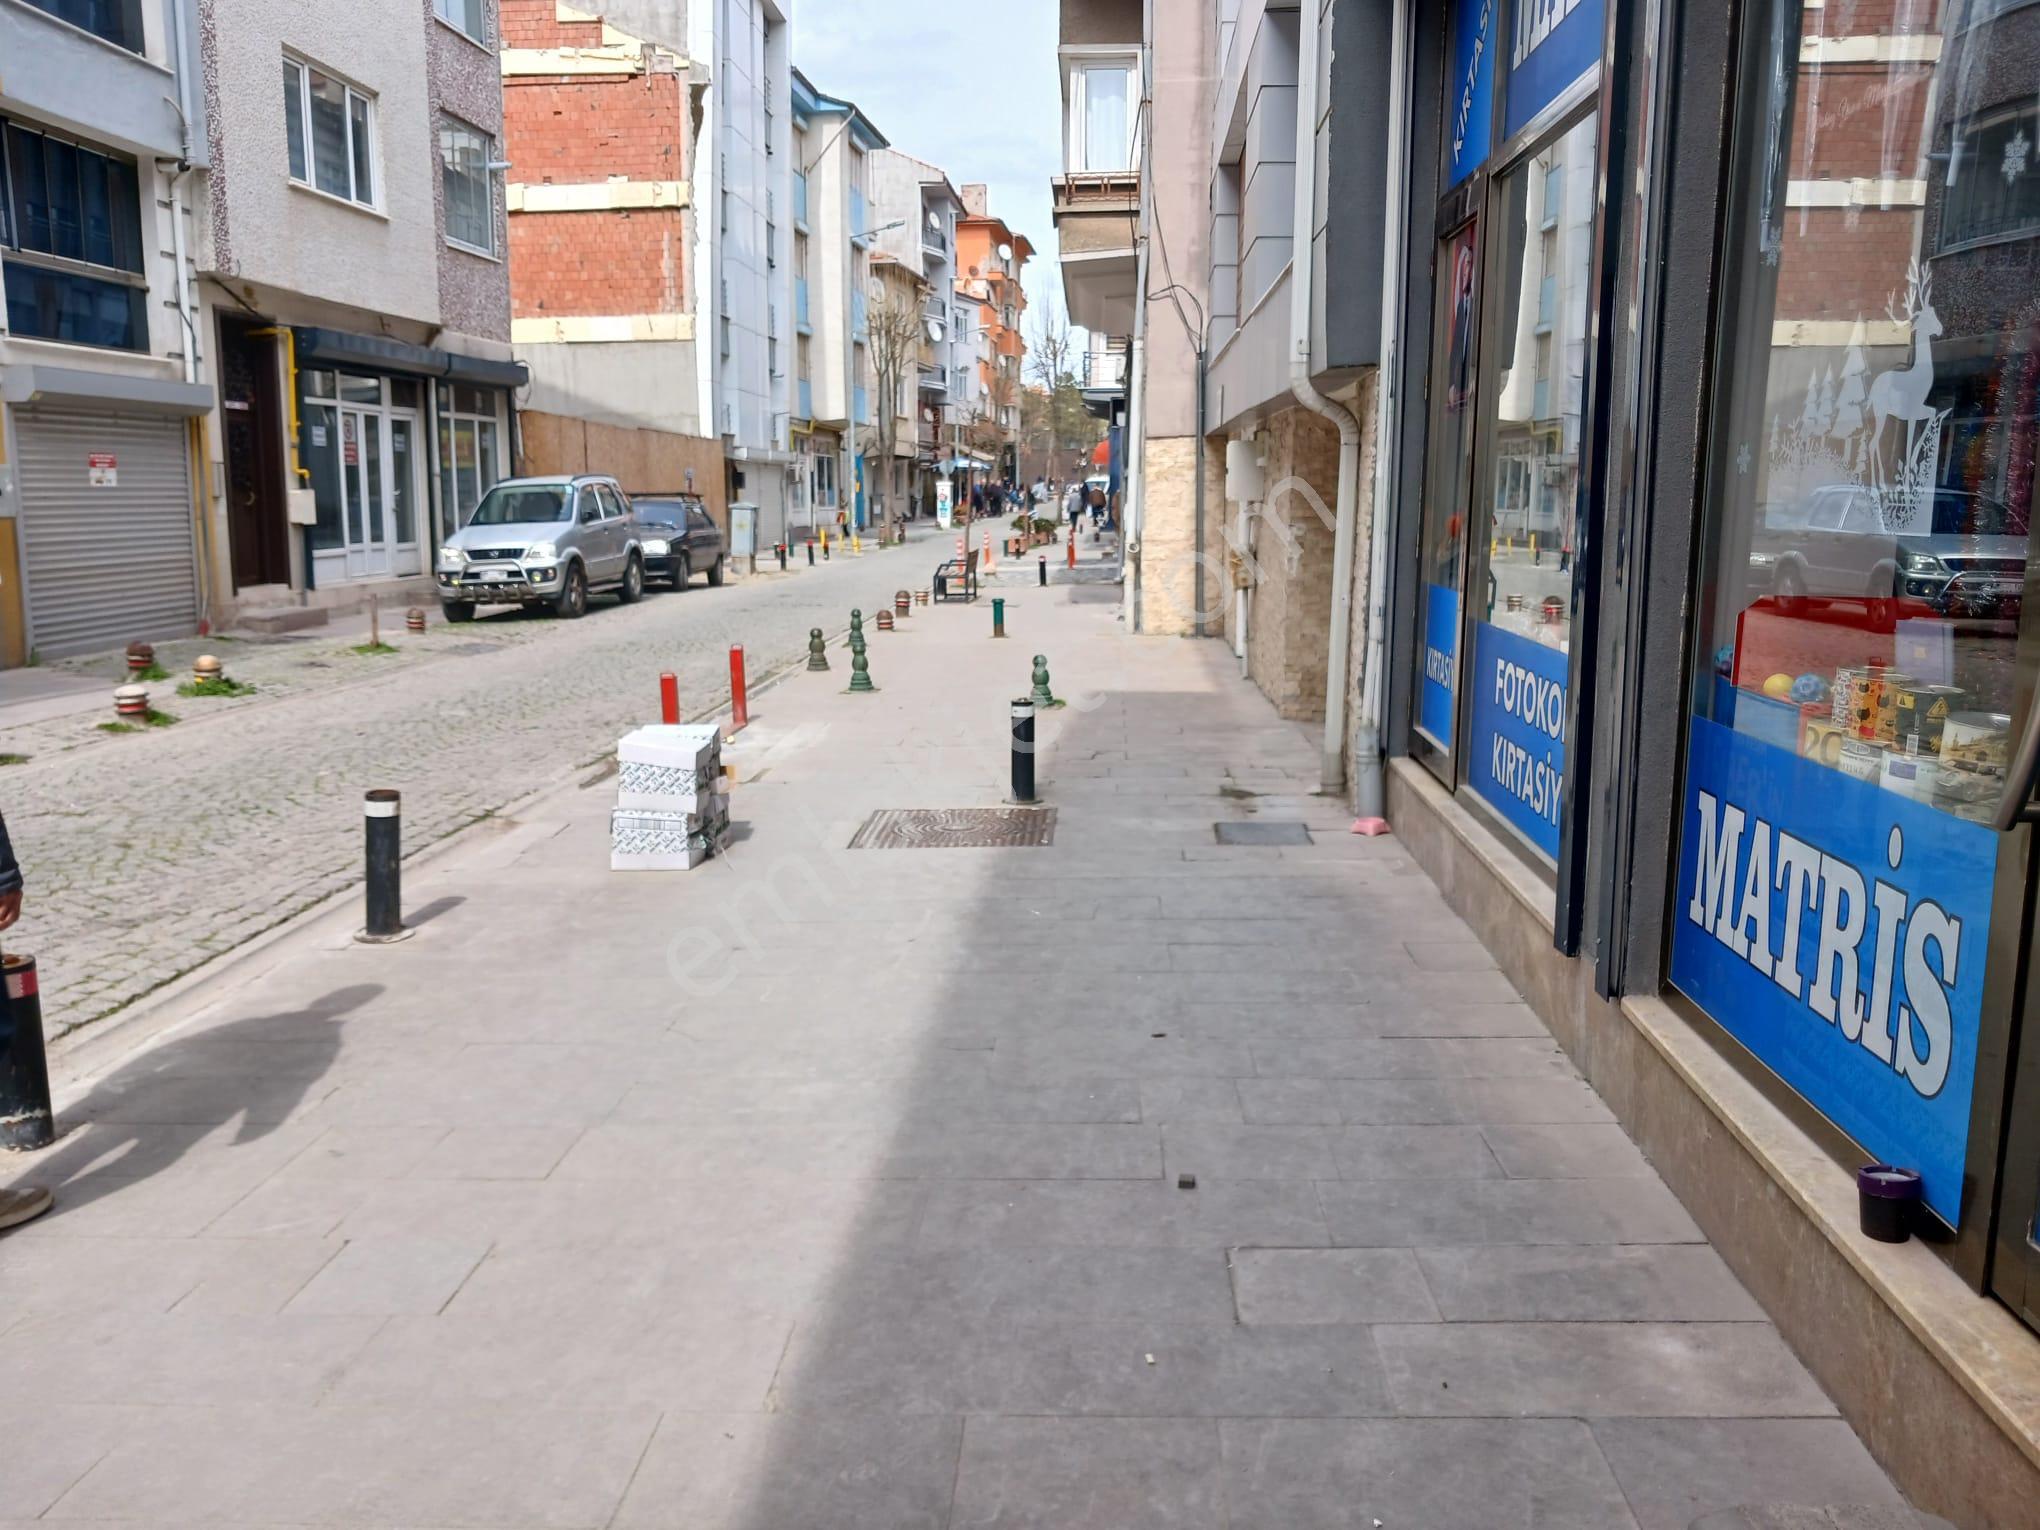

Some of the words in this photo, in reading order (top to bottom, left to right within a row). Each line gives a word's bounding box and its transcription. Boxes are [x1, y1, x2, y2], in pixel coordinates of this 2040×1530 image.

[1494, 657, 1567, 743] FOTOKO
[1491, 732, 1563, 826] KIRTASİY
[1689, 788, 1963, 1100] MATRİS
